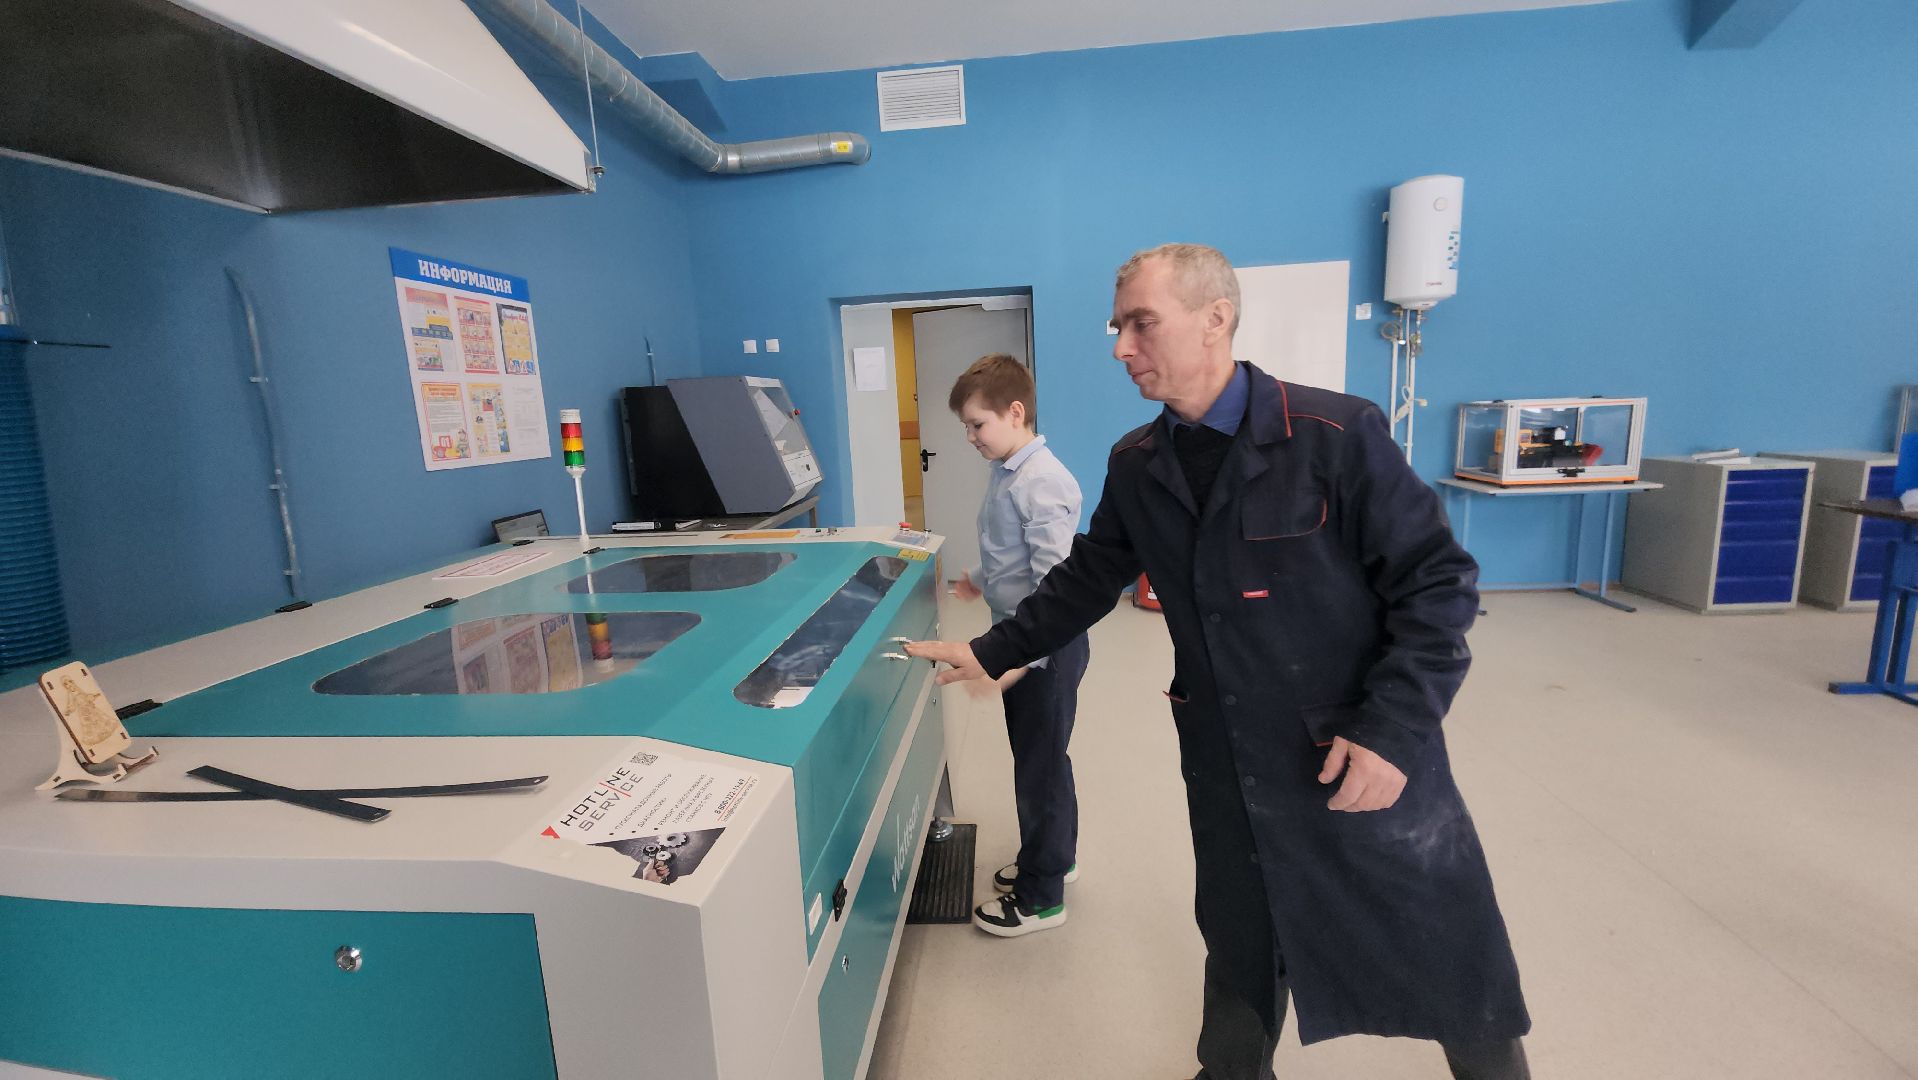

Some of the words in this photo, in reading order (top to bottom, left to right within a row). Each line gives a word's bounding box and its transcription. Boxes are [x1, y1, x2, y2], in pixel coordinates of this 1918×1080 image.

[418, 259, 512, 294] ИНФОРМАЦИЯ
[560, 767, 631, 826] HOTLINE
[578, 774, 643, 831] SERVICE
